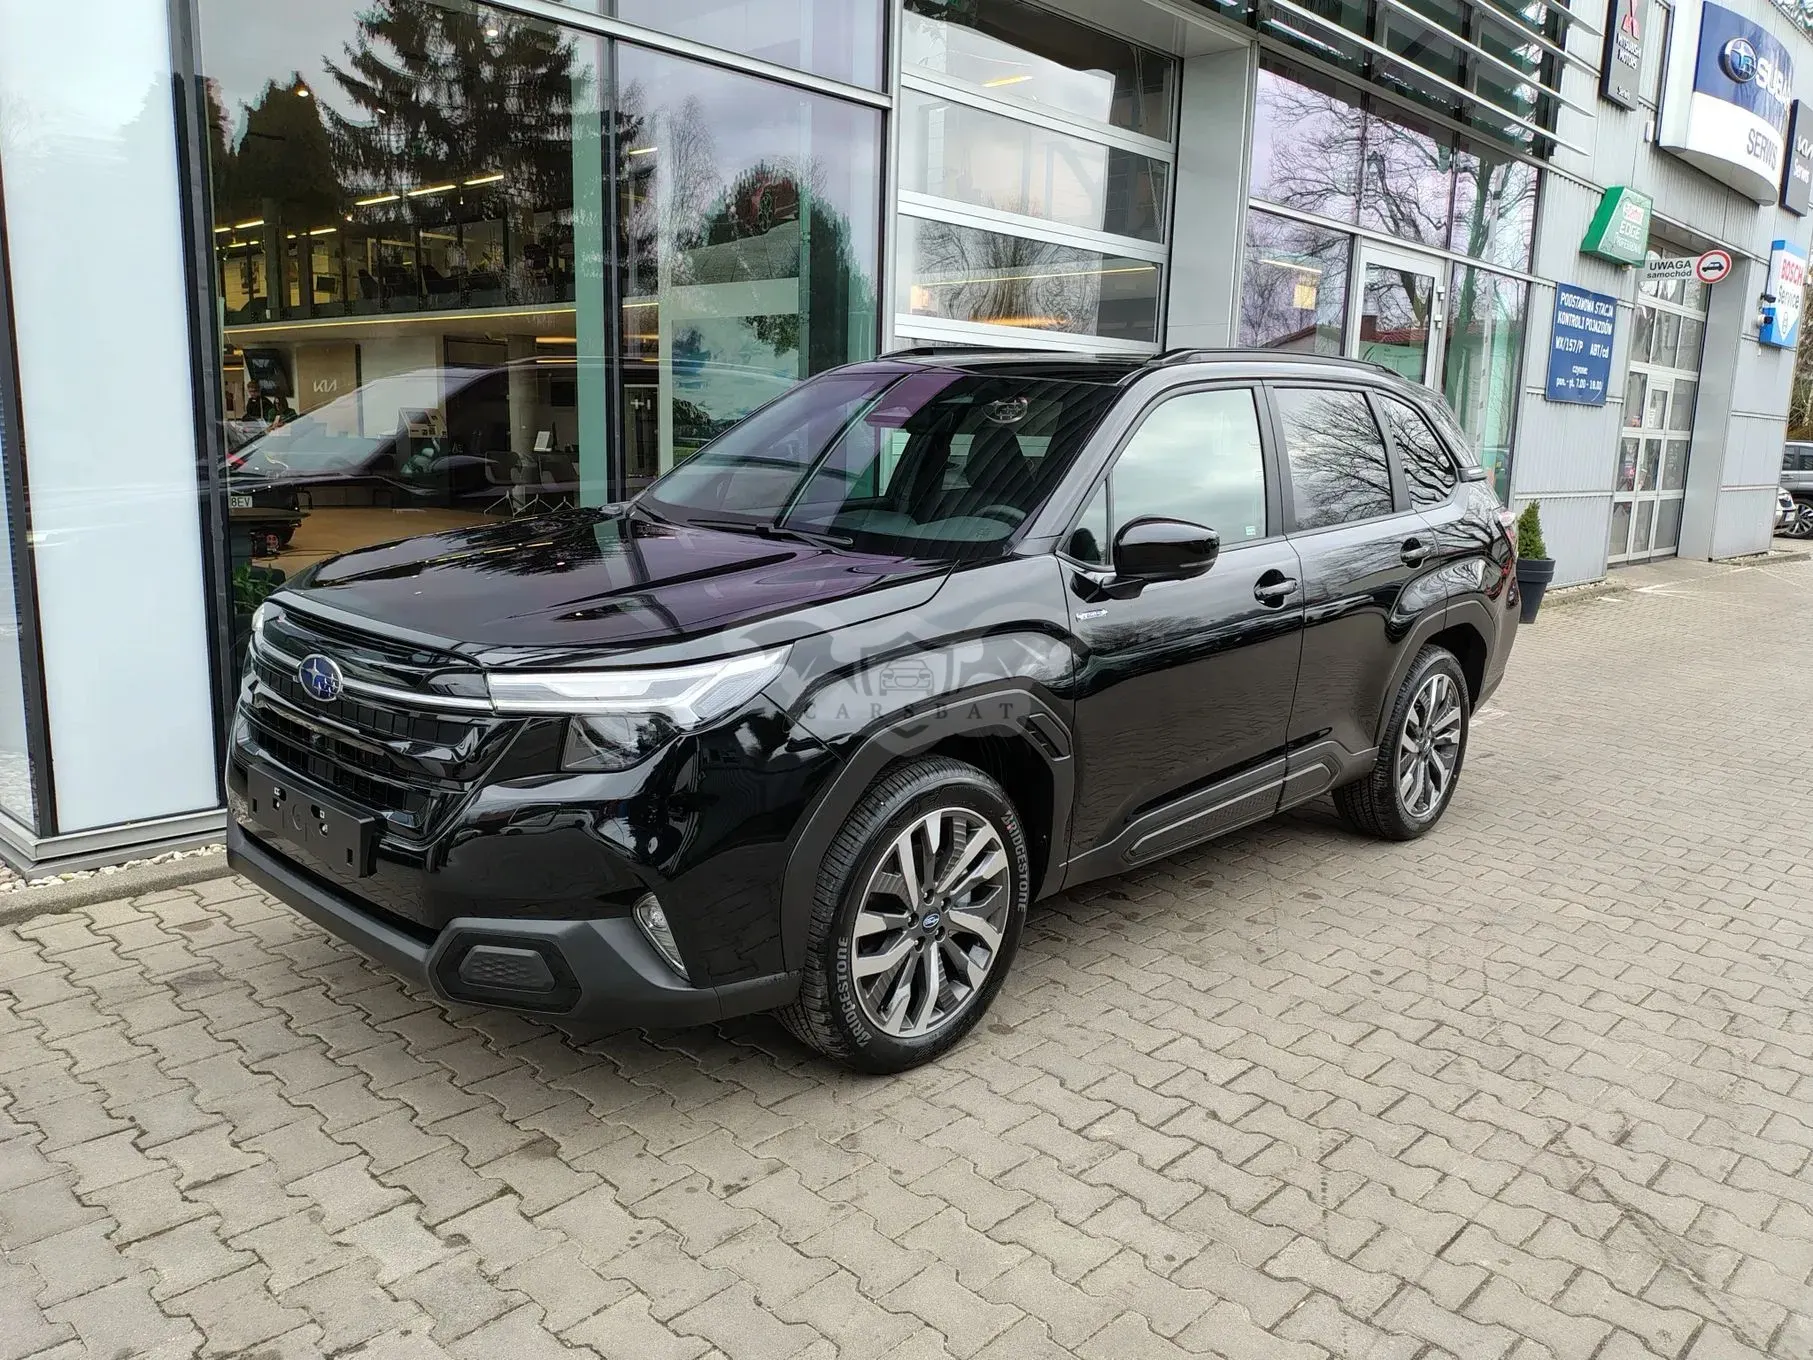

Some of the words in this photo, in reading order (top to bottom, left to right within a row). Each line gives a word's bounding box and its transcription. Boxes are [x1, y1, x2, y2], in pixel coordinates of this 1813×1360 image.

[1747, 128, 1778, 171] SERWIS
[1647, 270, 1692, 278] samochód
[1650, 260, 1691, 270] UWAGA
[1781, 259, 1804, 286] BOSCH
[1594, 302, 1613, 317] STACJA
[1557, 311, 1585, 329] KONTROLI
[1585, 318, 1613, 335] POJAZDÓW
[313, 379, 337, 392] KIA
[1001, 809, 1030, 913] BRIDGESTONE
[837, 936, 873, 1048] BRIDGESTONE
